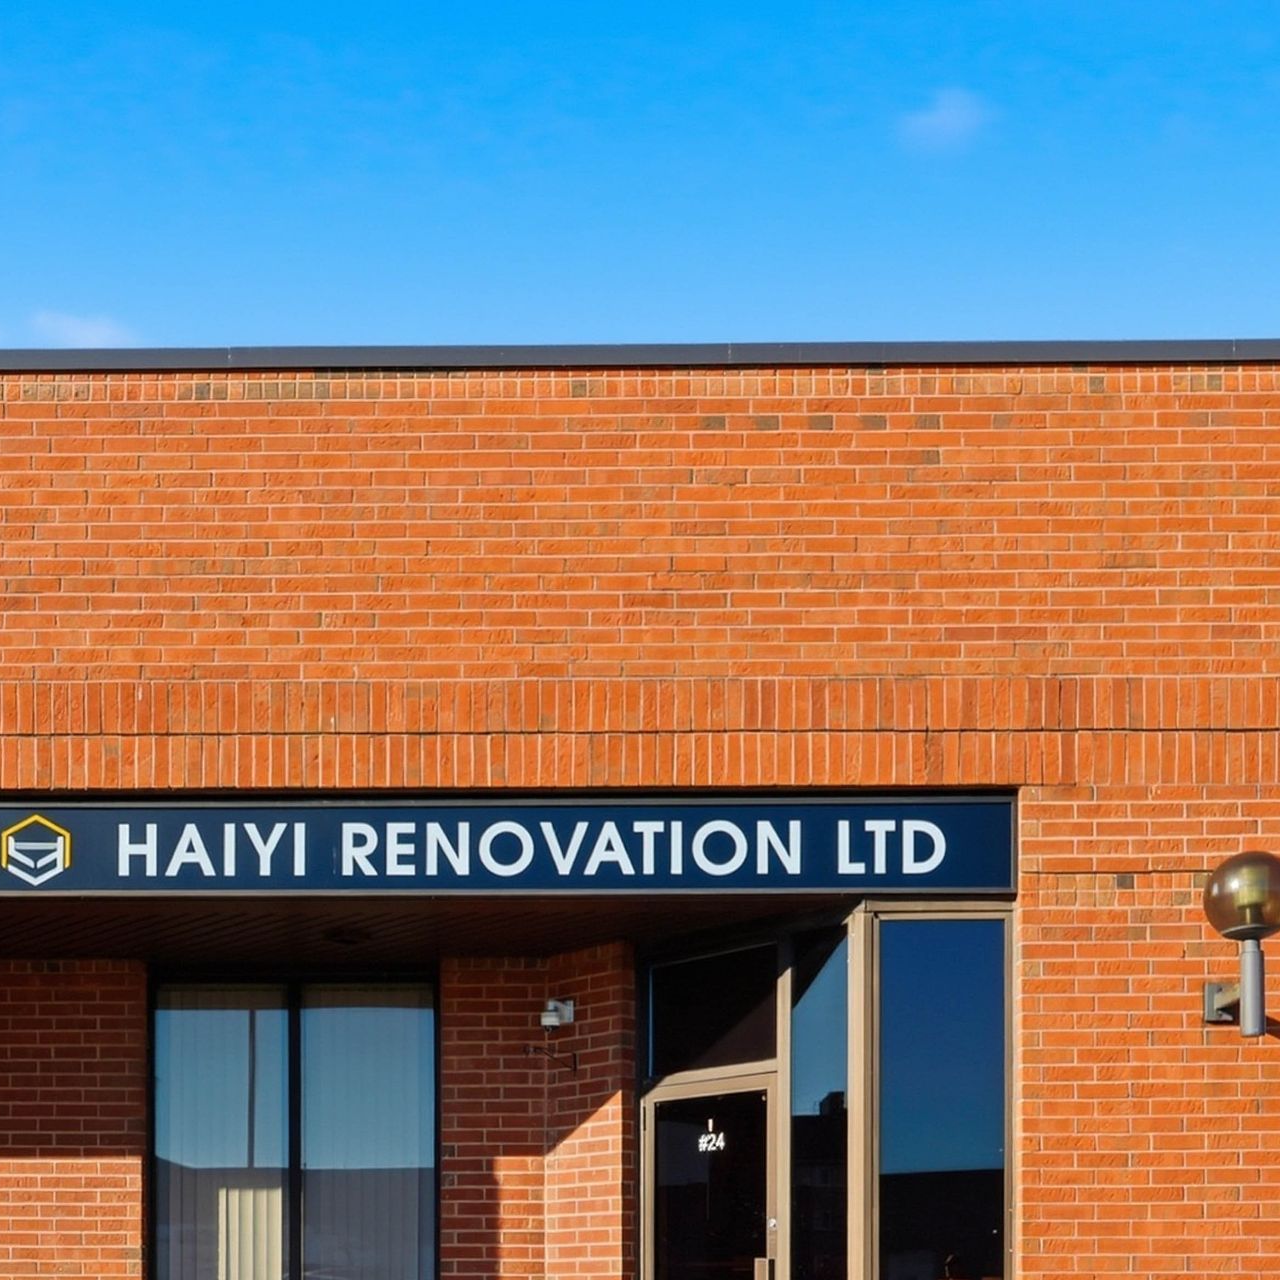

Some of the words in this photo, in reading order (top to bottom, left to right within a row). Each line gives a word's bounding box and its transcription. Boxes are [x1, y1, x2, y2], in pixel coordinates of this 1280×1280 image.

[118, 822, 307, 877] HAIYI
[341, 820, 801, 877] RENOVATION
[837, 819, 947, 875] LTD
[698, 1132, 725, 1152] #24
